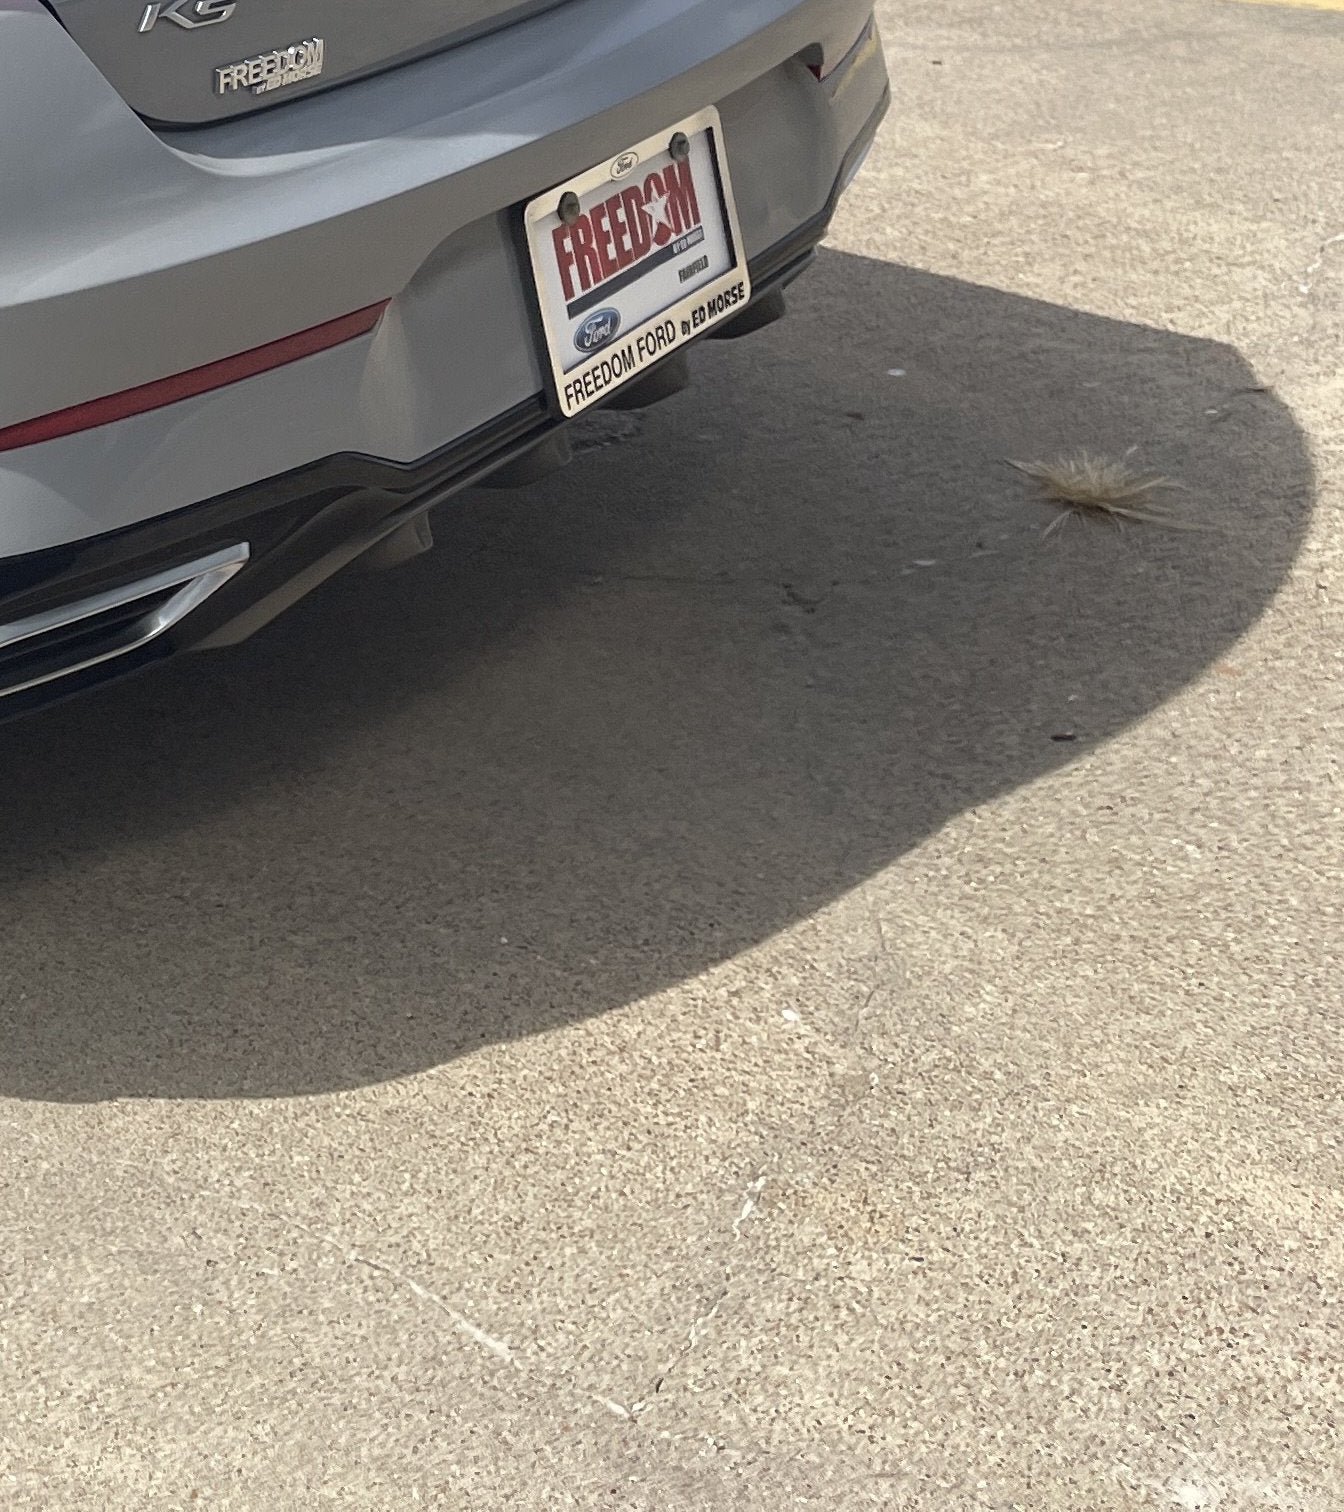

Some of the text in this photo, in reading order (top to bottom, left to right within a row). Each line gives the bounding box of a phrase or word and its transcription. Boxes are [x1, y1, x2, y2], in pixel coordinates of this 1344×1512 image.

[215, 37, 324, 94] FREEDOM
[551, 157, 702, 302] FREEDOM
[564, 344, 636, 411] FREEDOM
[636, 319, 676, 362] FORD
[692, 306, 706, 330] ED
[706, 281, 745, 320] MORSE
[583, 312, 613, 348] Ford
